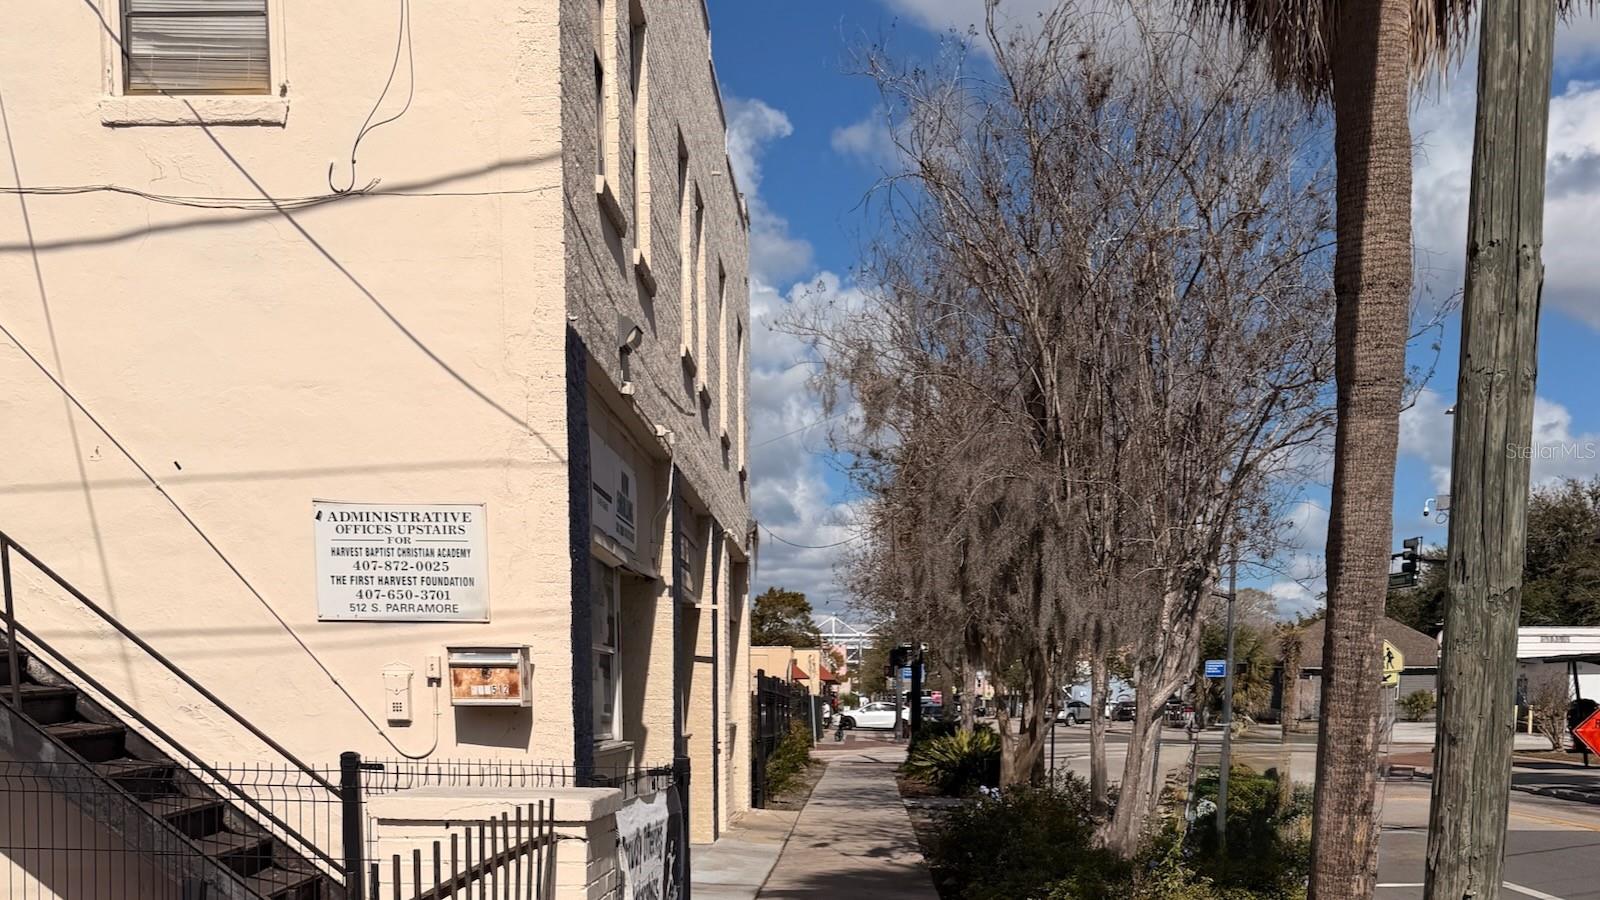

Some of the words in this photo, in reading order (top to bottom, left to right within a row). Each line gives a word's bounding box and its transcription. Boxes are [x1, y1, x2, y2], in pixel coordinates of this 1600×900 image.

[327, 511, 472, 523] ADMINISTRATIVE
[335, 524, 392, 535] OFFICES
[397, 525, 466, 535] UPSTAIRS
[387, 537, 412, 545] FOR
[331, 547, 363, 557] HARVEST
[365, 547, 395, 557] BAPTIST
[397, 548, 435, 558] CHRISTIAN
[437, 548, 471, 558] ACADEMY
[352, 560, 450, 572] 407-872-0025
[330, 575, 347, 585] THE
[350, 576, 374, 586] FIRST
[377, 576, 417, 586] HARVEST
[421, 576, 475, 587] FOUNDATION
[355, 589, 452, 601] 407-650-3701
[349, 603, 367, 613] 512
[371, 603, 382, 613] S.
[386, 603, 459, 614] PARRAMORE
